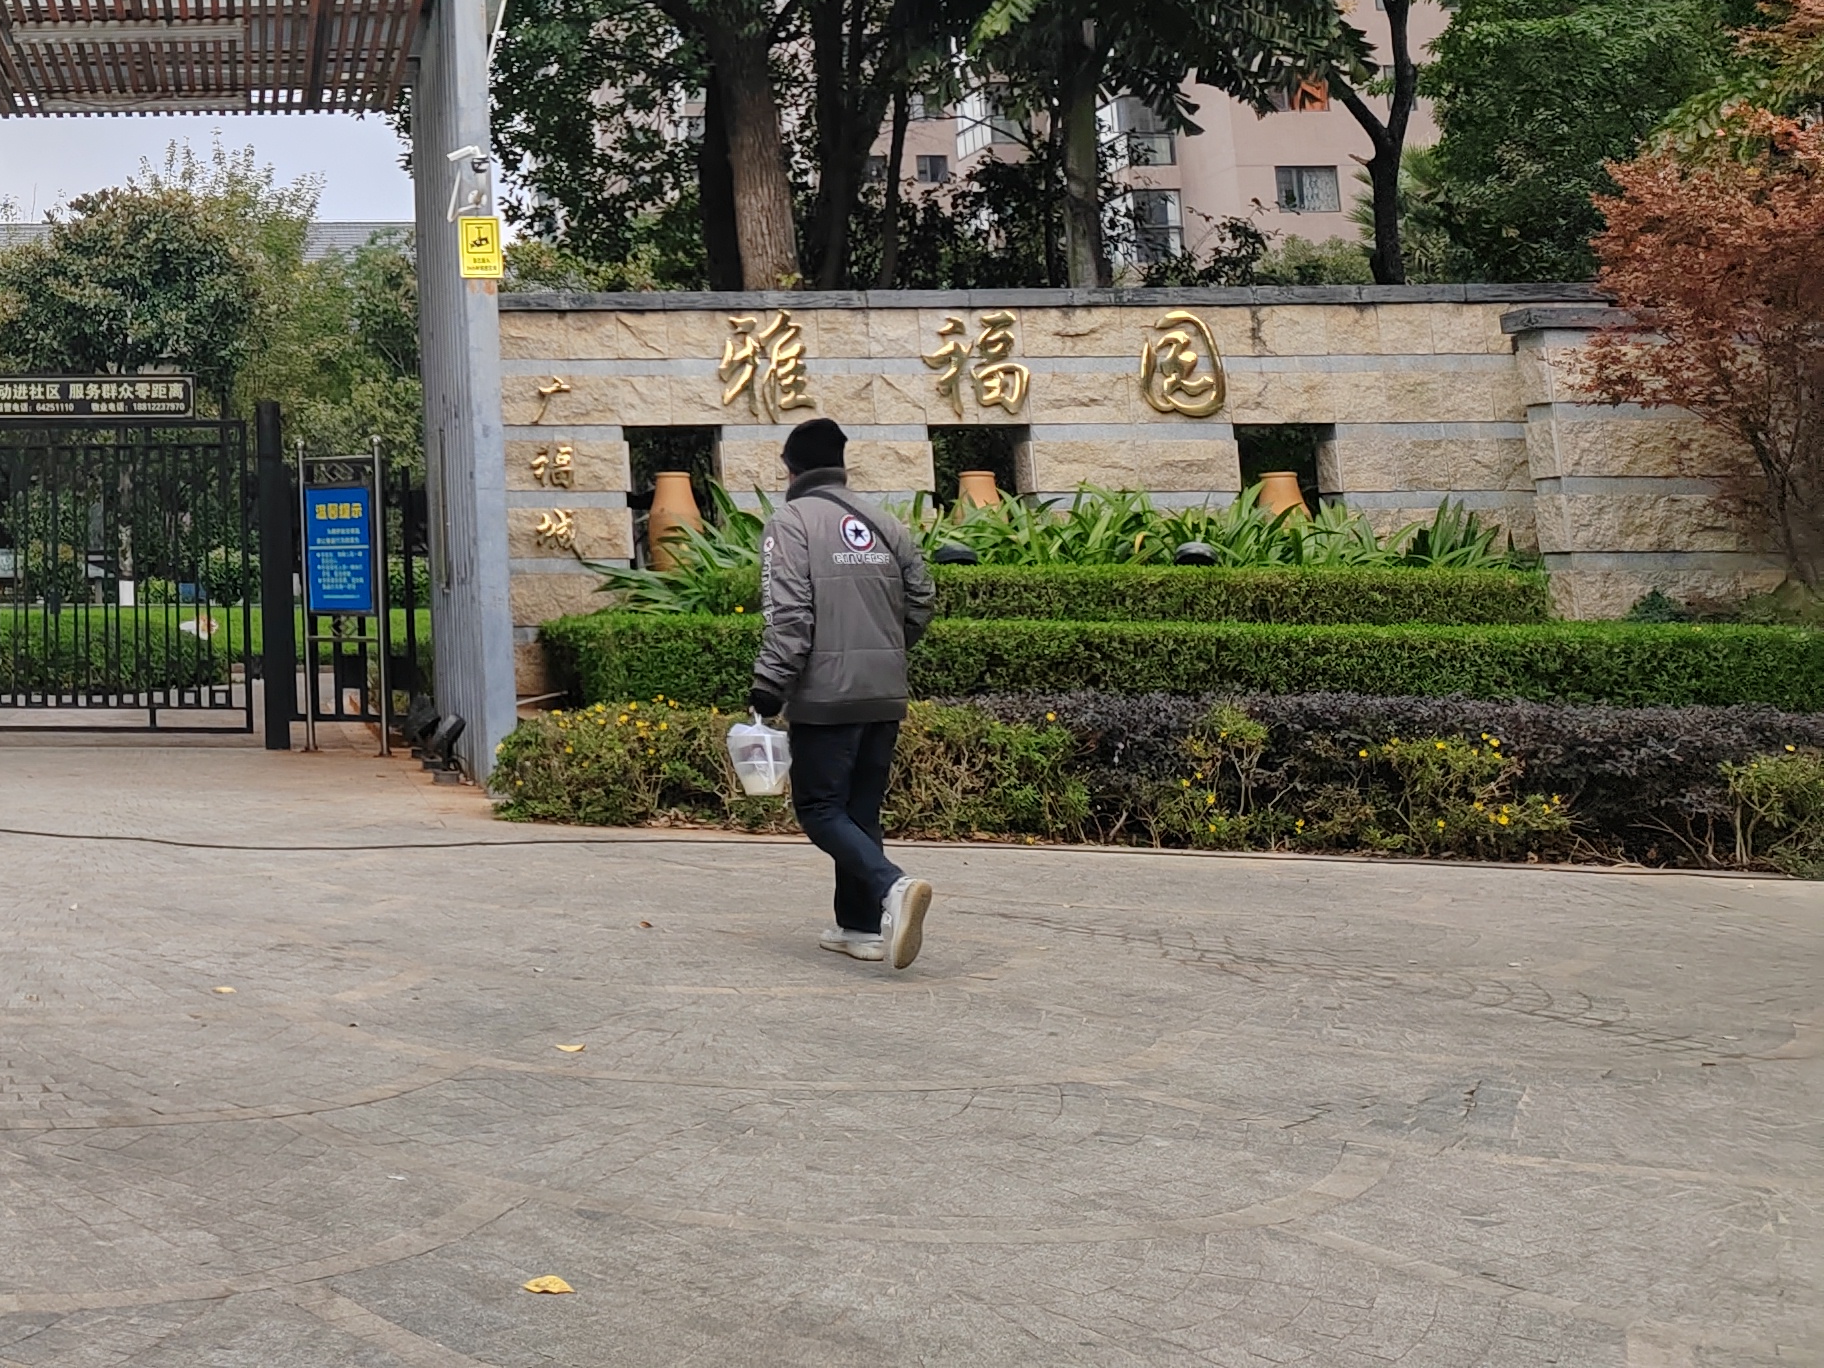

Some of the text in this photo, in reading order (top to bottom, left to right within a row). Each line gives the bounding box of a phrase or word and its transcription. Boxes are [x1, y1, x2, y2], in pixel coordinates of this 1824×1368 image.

[69, 383, 184, 400] 服务群众零距离
